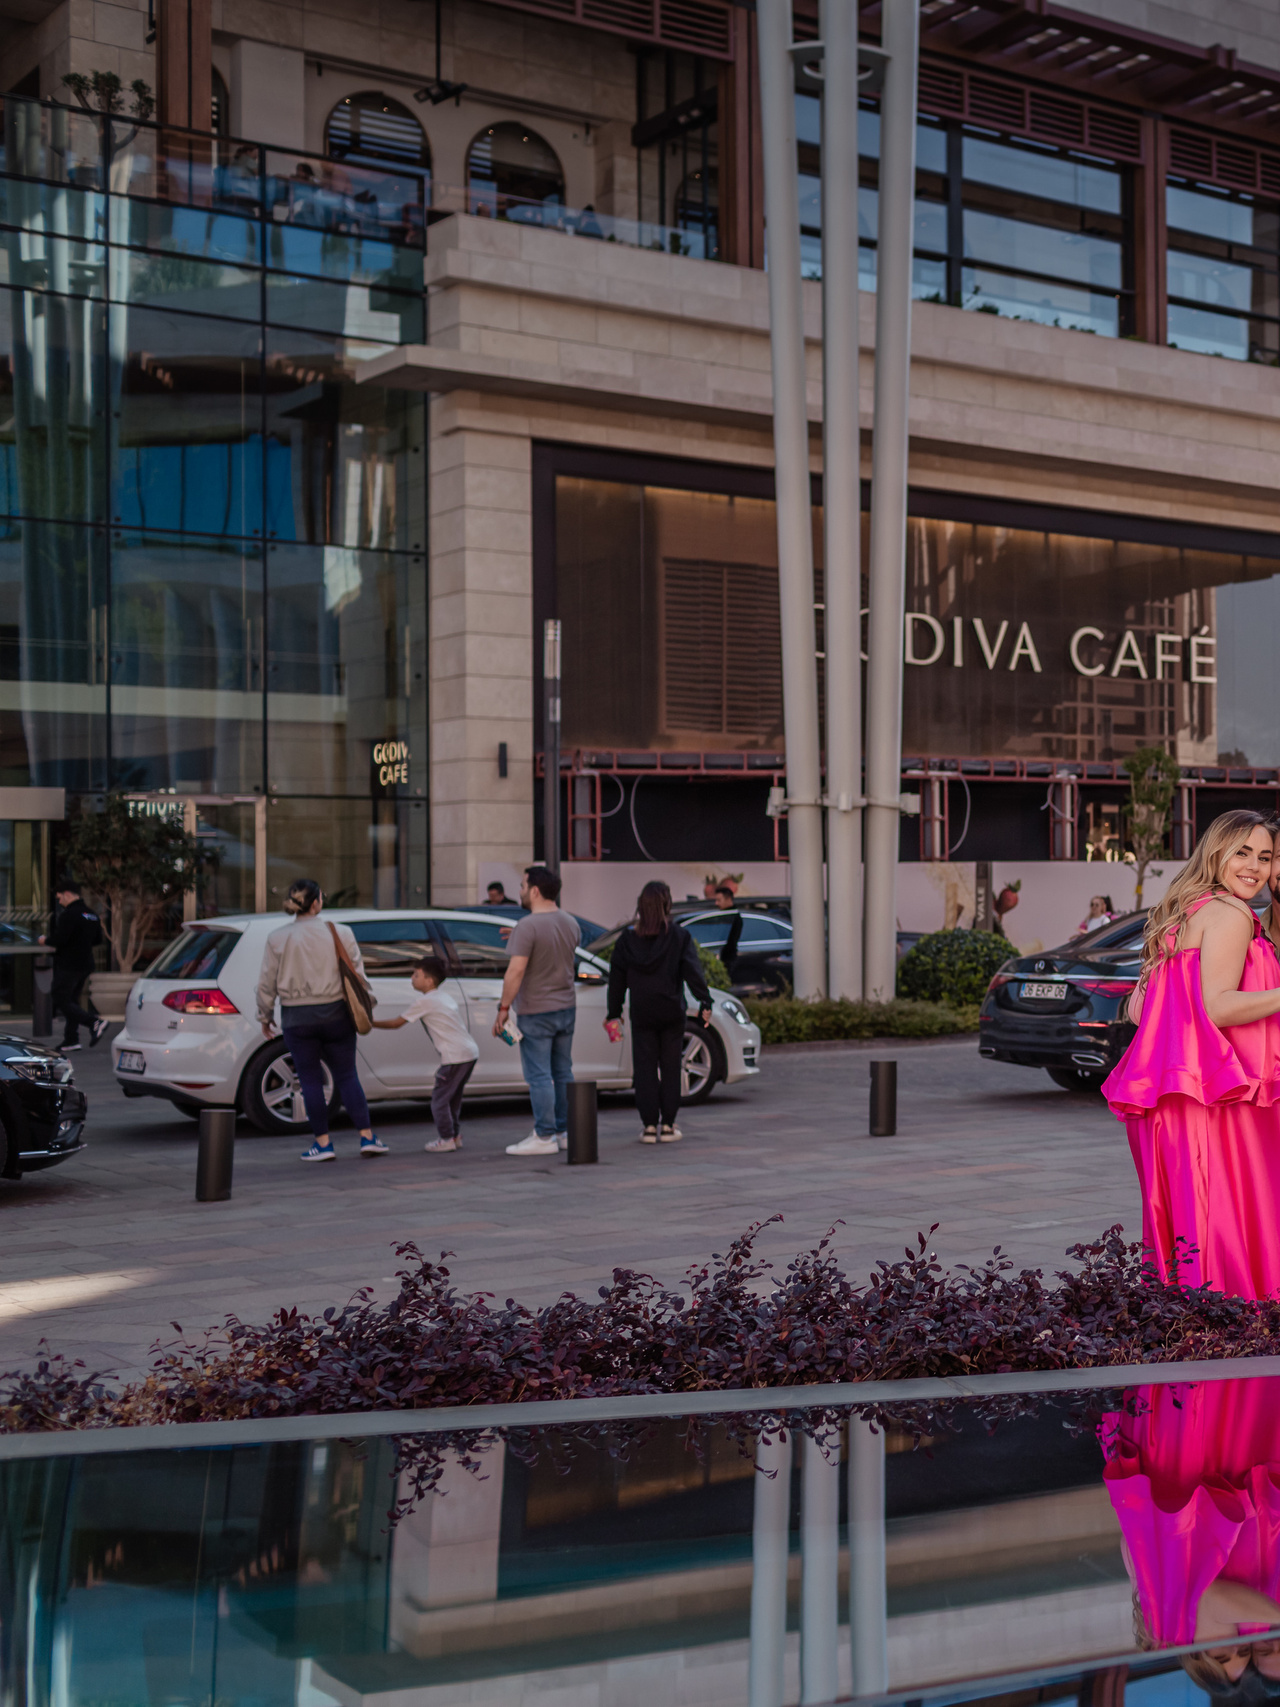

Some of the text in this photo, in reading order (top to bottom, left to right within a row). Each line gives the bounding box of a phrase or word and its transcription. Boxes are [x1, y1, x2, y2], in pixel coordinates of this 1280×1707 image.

[813, 603, 1218, 683] DIVA CAFÉ
[373, 741, 412, 764] GODIV
[1024, 983, 1065, 998] 06 EKP 06
